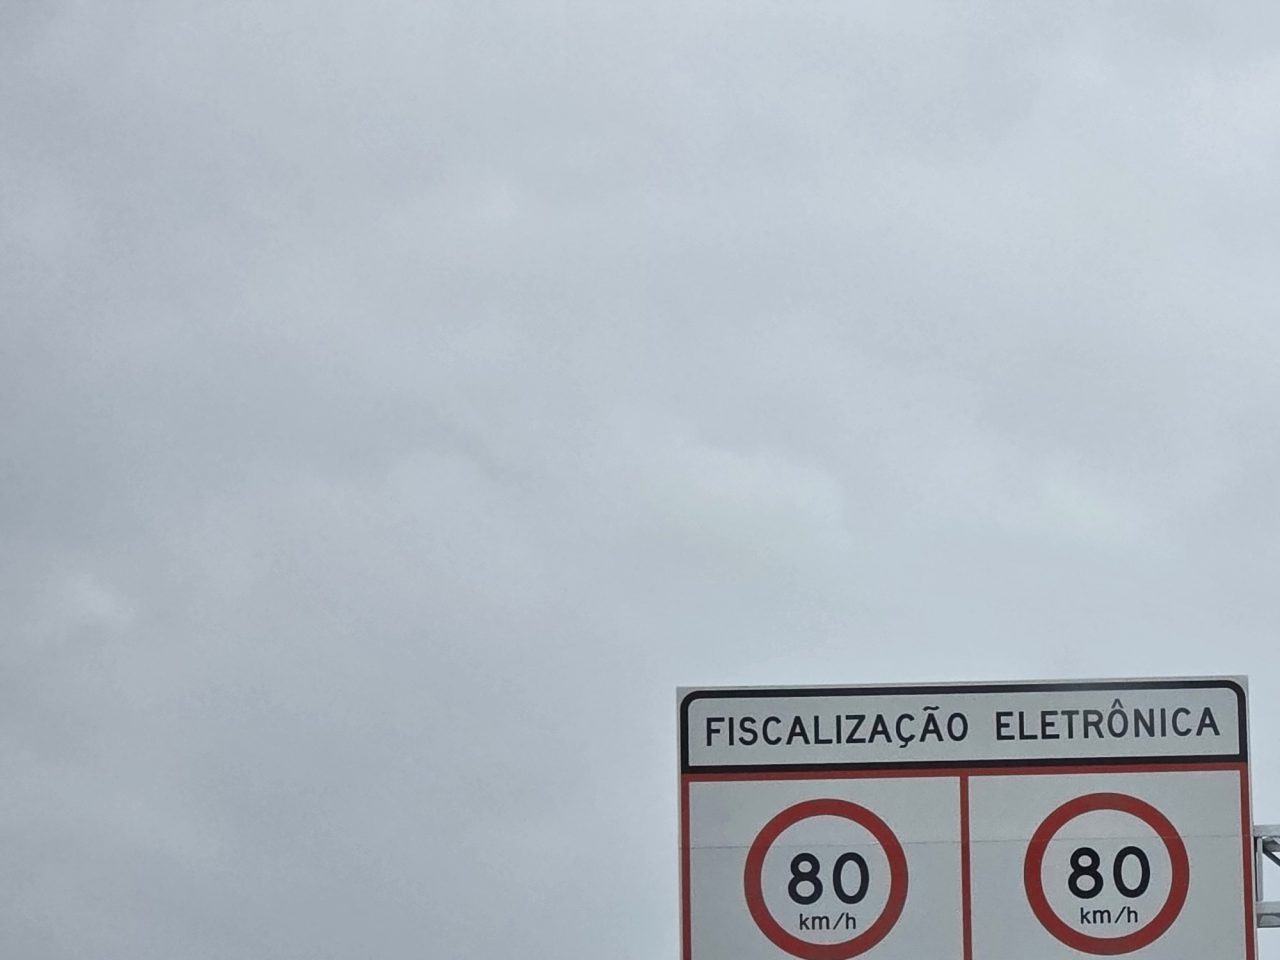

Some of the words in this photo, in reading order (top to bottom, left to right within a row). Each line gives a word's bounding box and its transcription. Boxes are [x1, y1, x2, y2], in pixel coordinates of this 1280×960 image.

[705, 706, 969, 749] FISCALIZAÇÃO
[995, 698, 1221, 741] ELETRÔNICA
[787, 851, 870, 905] 80
[1067, 846, 1151, 899] 80
[799, 912, 857, 931] km/h
[1079, 906, 1139, 925] km/h
